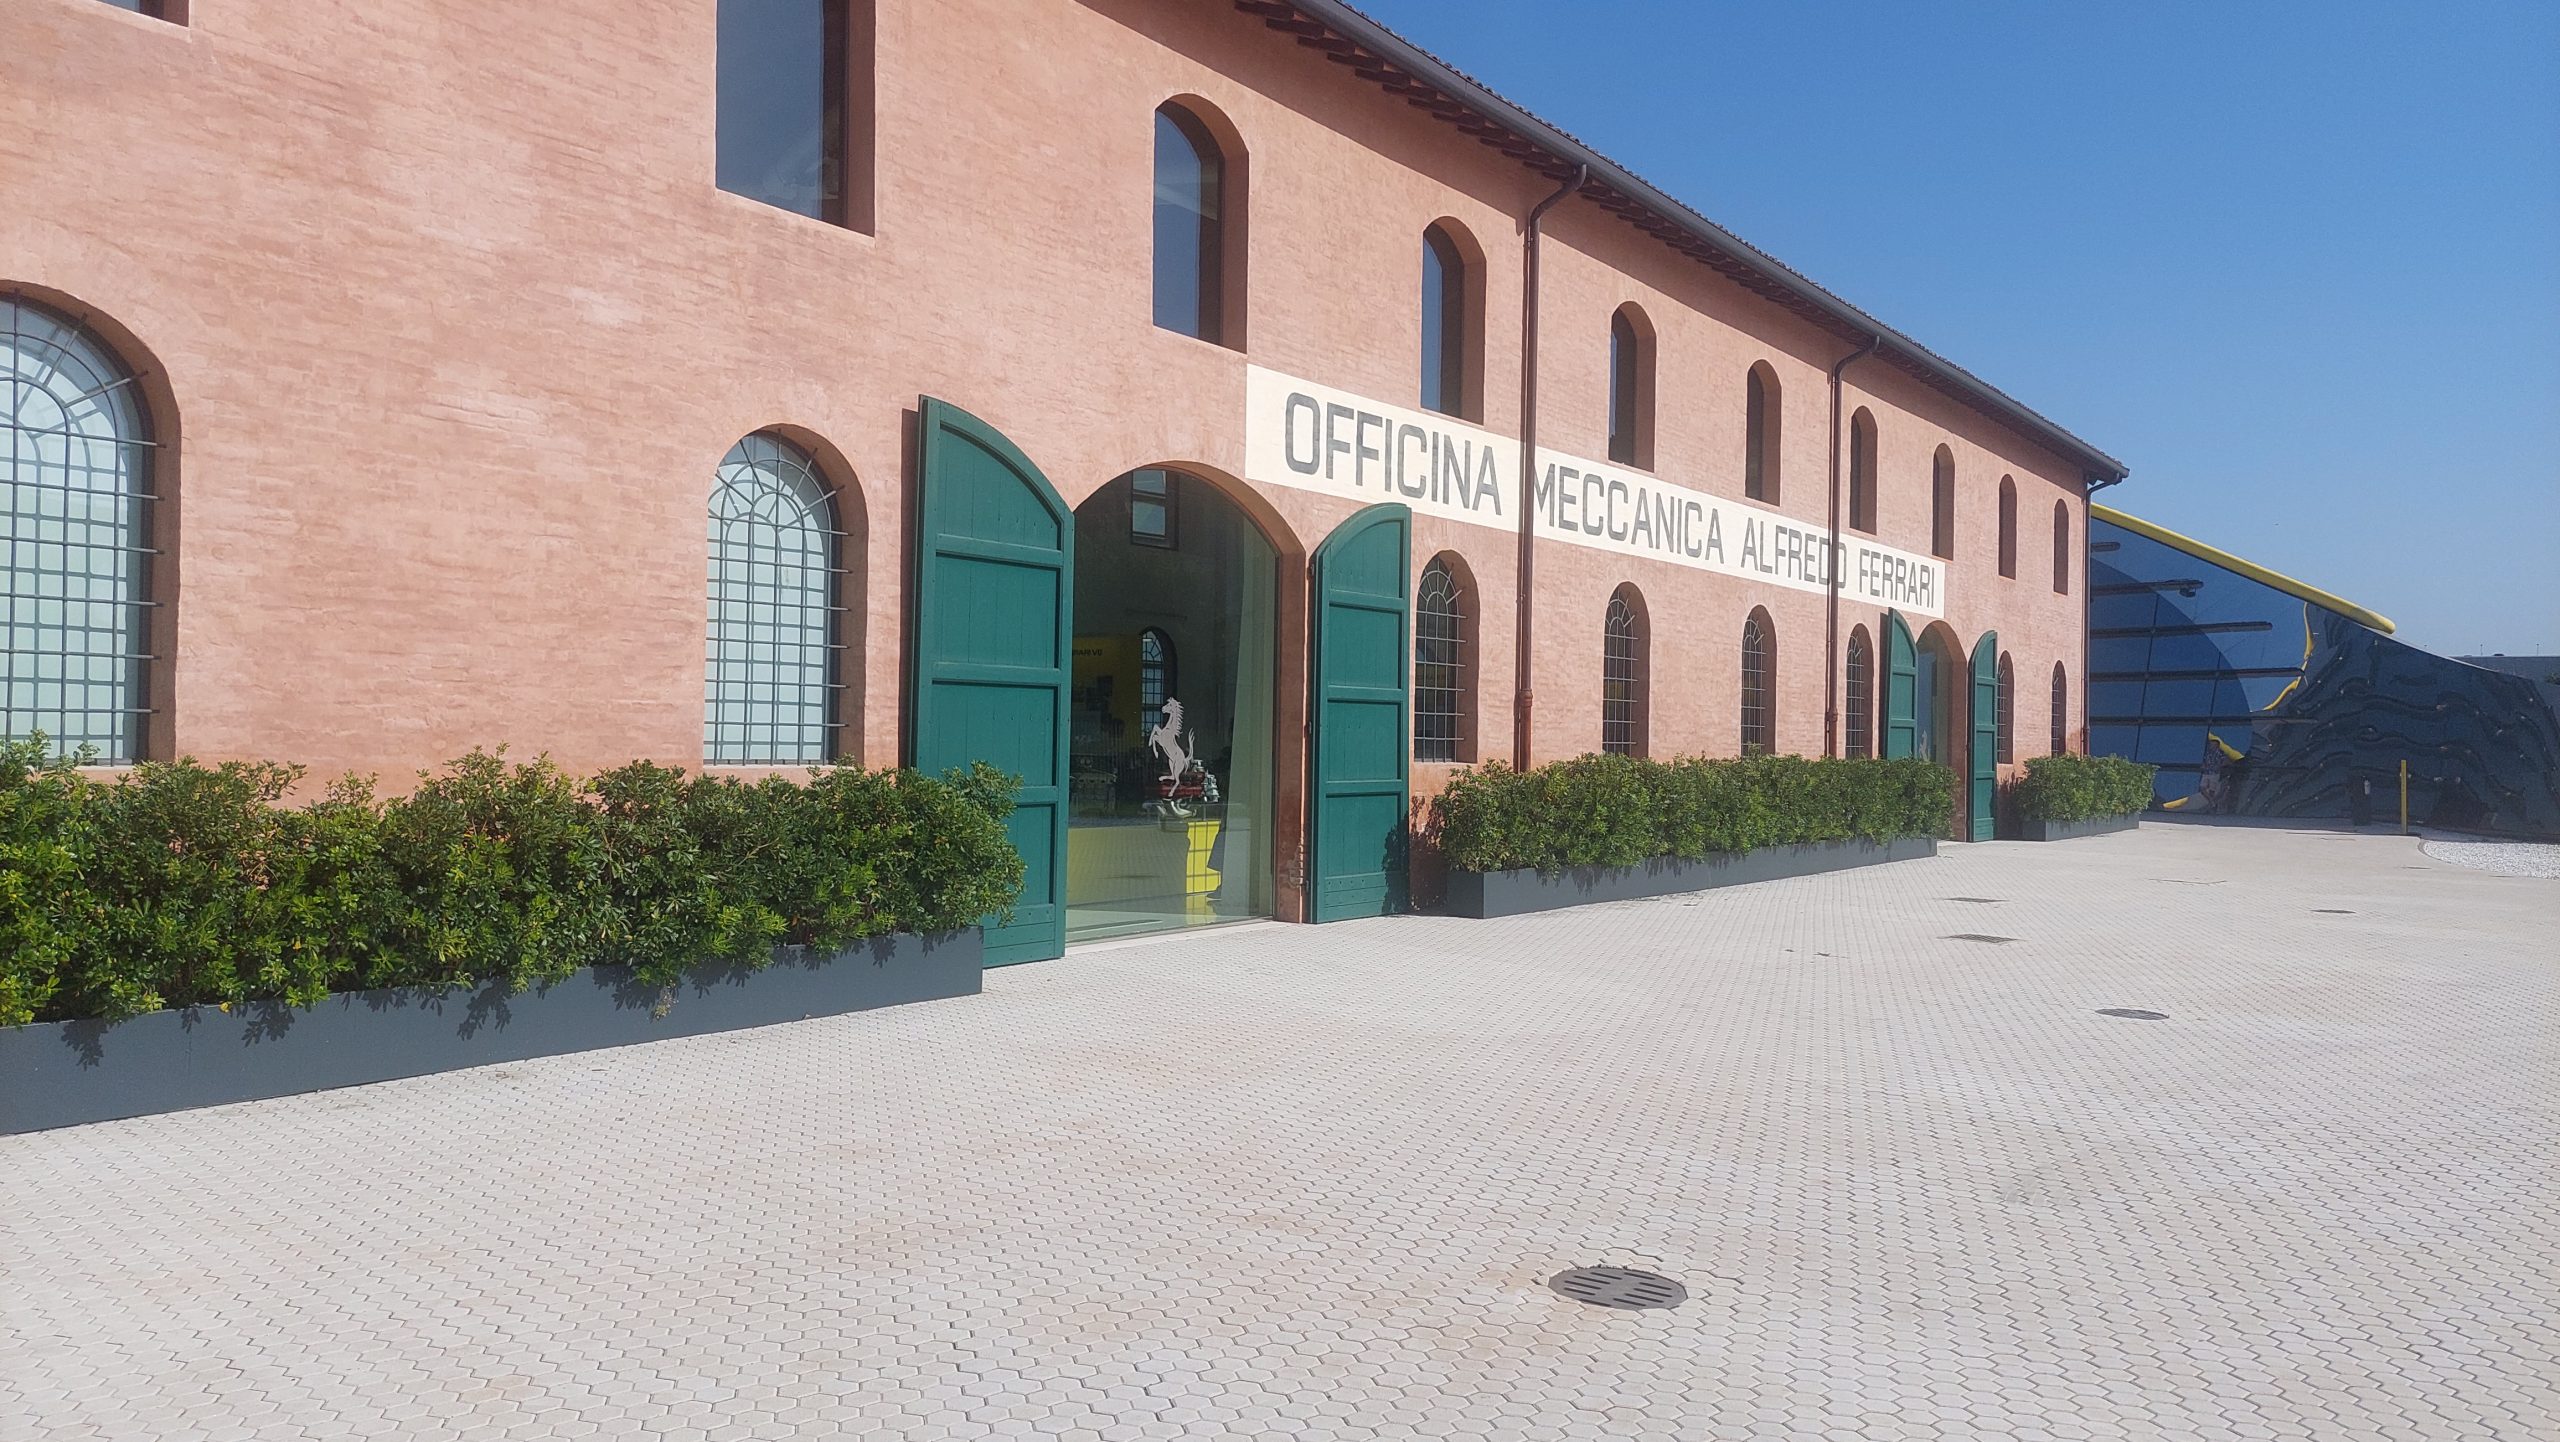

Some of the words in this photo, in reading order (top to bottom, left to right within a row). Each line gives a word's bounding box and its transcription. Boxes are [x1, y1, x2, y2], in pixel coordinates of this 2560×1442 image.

[1285, 392, 1502, 516] OFFICINA
[1534, 463, 1724, 564] MECCANICA
[1741, 517, 1847, 589] ALFREDO
[1859, 548, 1935, 609] FERRARI
